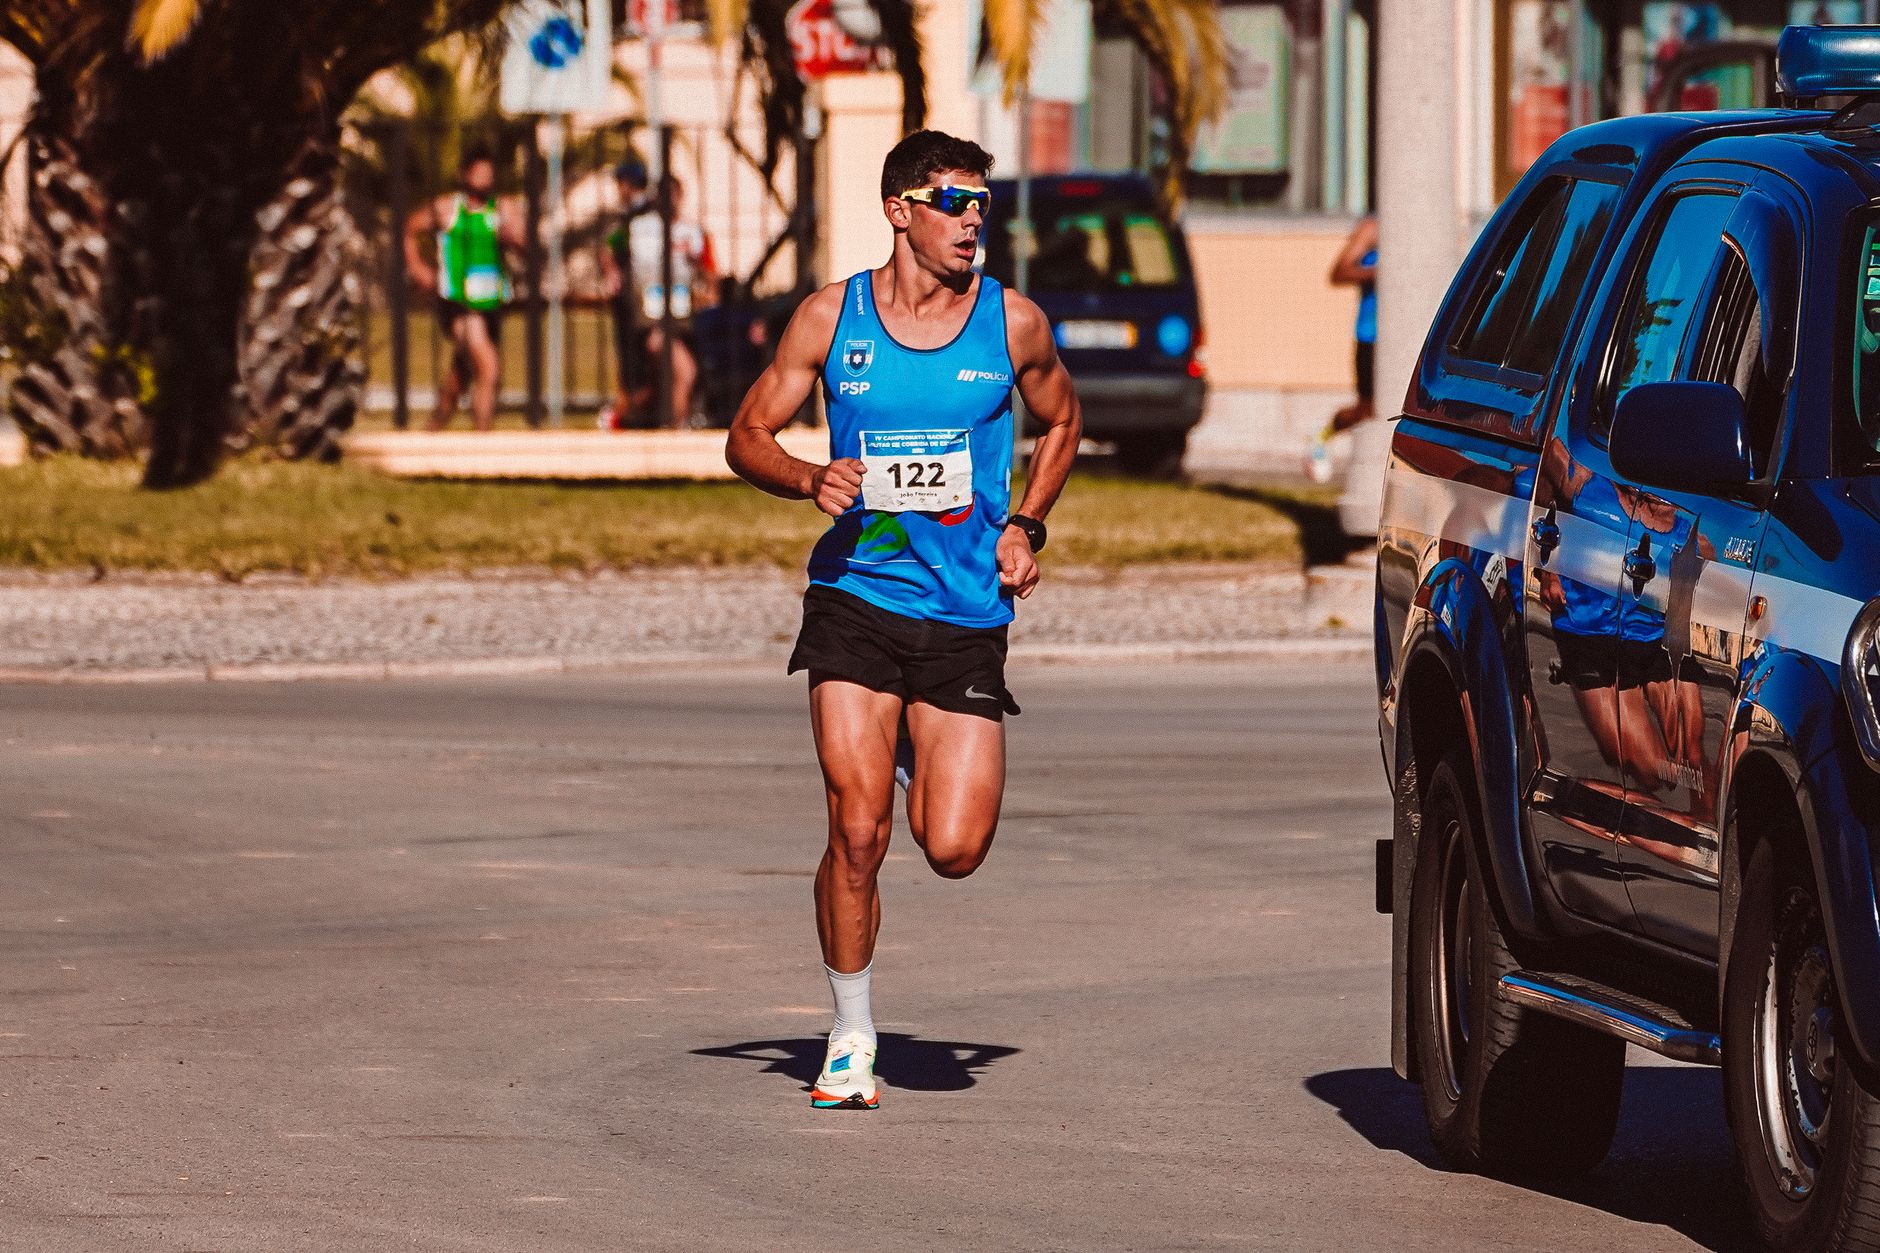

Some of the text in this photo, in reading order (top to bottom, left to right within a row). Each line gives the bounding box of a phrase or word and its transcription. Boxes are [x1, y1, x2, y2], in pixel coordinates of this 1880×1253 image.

[978, 371, 1009, 381] POLÍCIA
[839, 381, 870, 395] PSP
[886, 462, 946, 489] 122
